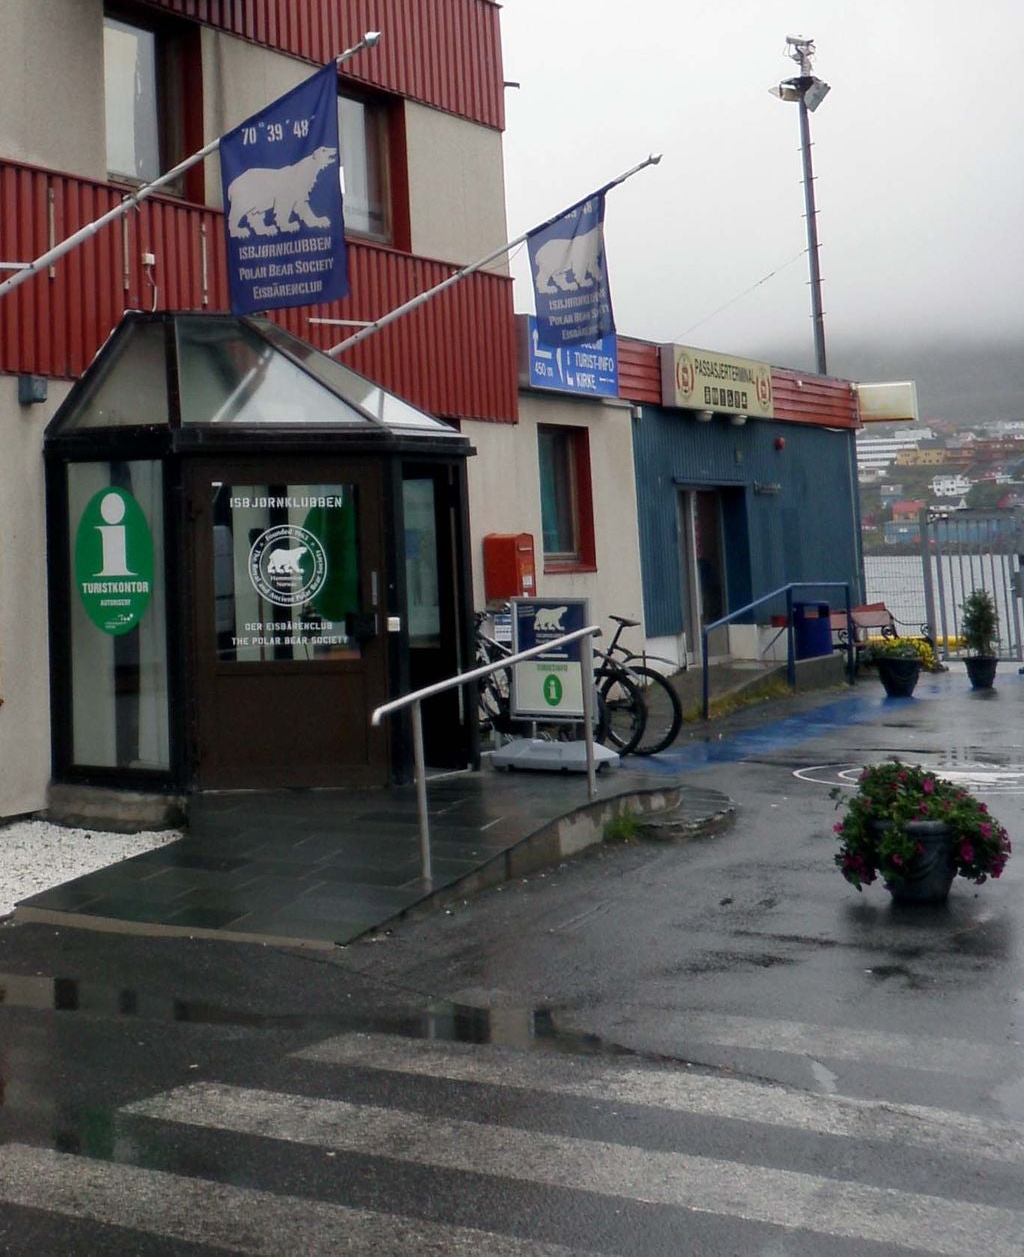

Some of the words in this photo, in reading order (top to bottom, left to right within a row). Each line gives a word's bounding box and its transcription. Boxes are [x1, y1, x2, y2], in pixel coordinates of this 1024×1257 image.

[239, 236, 332, 260] ISBJØRNKLUBBEN
[239, 266, 267, 281] POLAR
[269, 264, 294, 277] BEAR
[295, 258, 334, 274] SOCIETY
[535, 362, 546, 376] 450
[695, 359, 755, 384] PASSASJERTERMINAL
[576, 372, 596, 389] KIRKE
[82, 582, 149, 593] TURISTKONTOR
[232, 637, 249, 645] THE
[252, 636, 281, 645] POLAR
[284, 636, 308, 644] BEAR
[311, 636, 348, 644] SOCIETY
